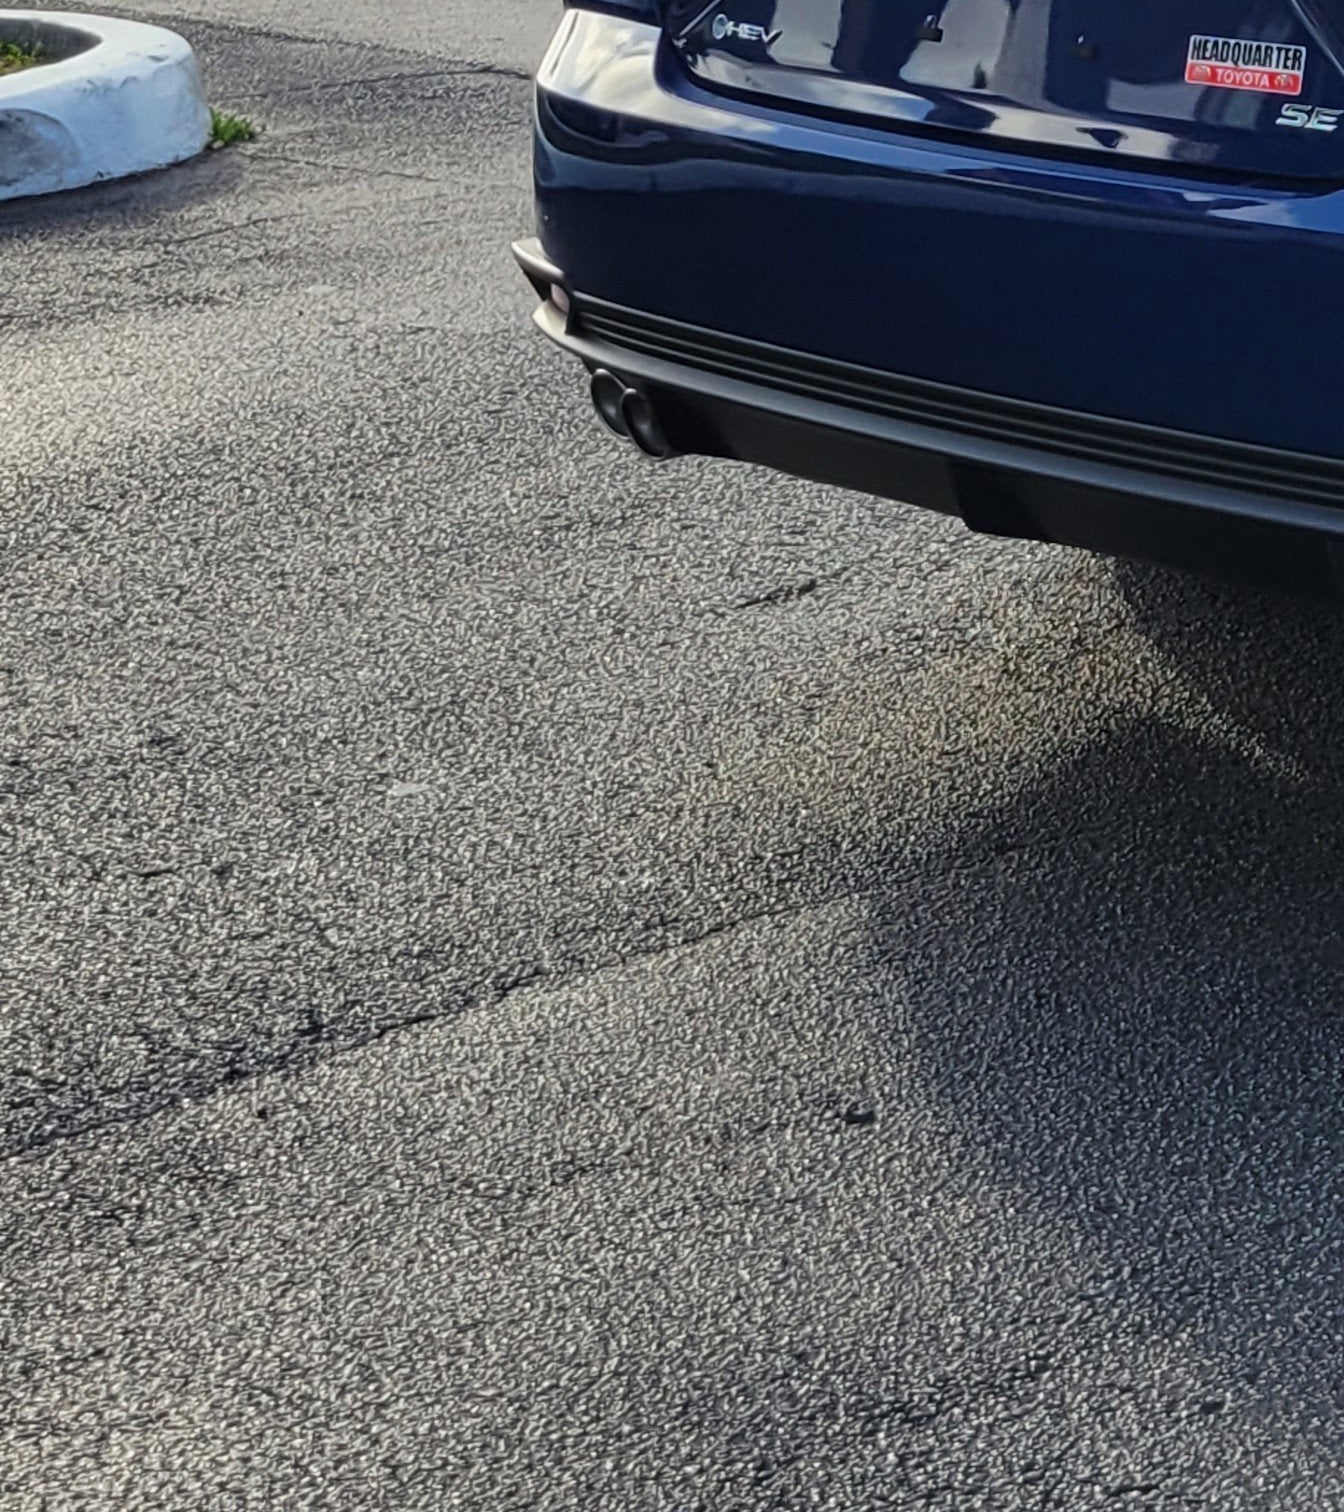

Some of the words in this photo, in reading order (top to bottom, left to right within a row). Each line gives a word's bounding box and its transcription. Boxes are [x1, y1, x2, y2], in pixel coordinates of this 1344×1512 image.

[1190, 37, 1304, 71] HEADQUARTER
[1215, 68, 1270, 88] TOYOTA
[1275, 103, 1344, 131] SE
